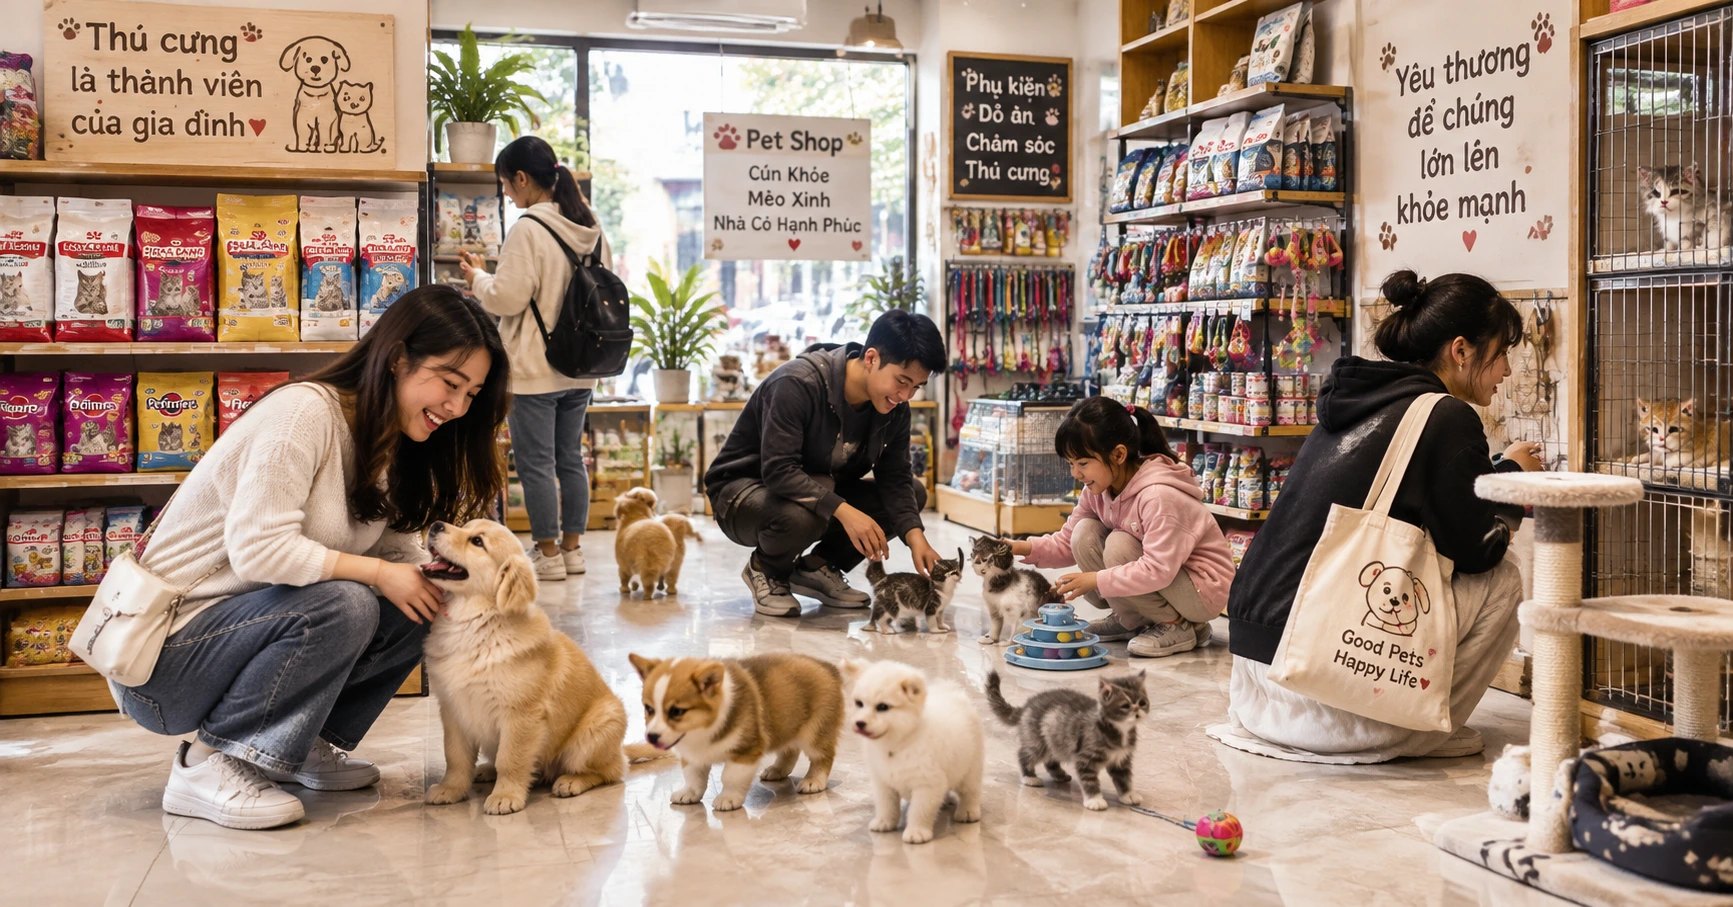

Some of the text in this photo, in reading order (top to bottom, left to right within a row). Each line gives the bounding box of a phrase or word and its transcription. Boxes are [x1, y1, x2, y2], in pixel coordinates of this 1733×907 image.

[86, 22, 237, 63] Thú cưng
[72, 66, 96, 92] là
[203, 70, 261, 97] viên
[1396, 43, 1530, 96] Yêu thương
[133, 110, 175, 143] gia
[1408, 93, 1514, 138] để chúng
[748, 129, 842, 156] Pet Shop
[749, 165, 781, 181] Cún
[1422, 148, 1454, 179] lớn
[792, 192, 830, 207] Xinh
[1398, 180, 1525, 224] khỏe mạnh
[778, 217, 817, 234] Hạnh
[1342, 629, 1424, 668] Good Pets
[1333, 649, 1418, 689] Happy Life
